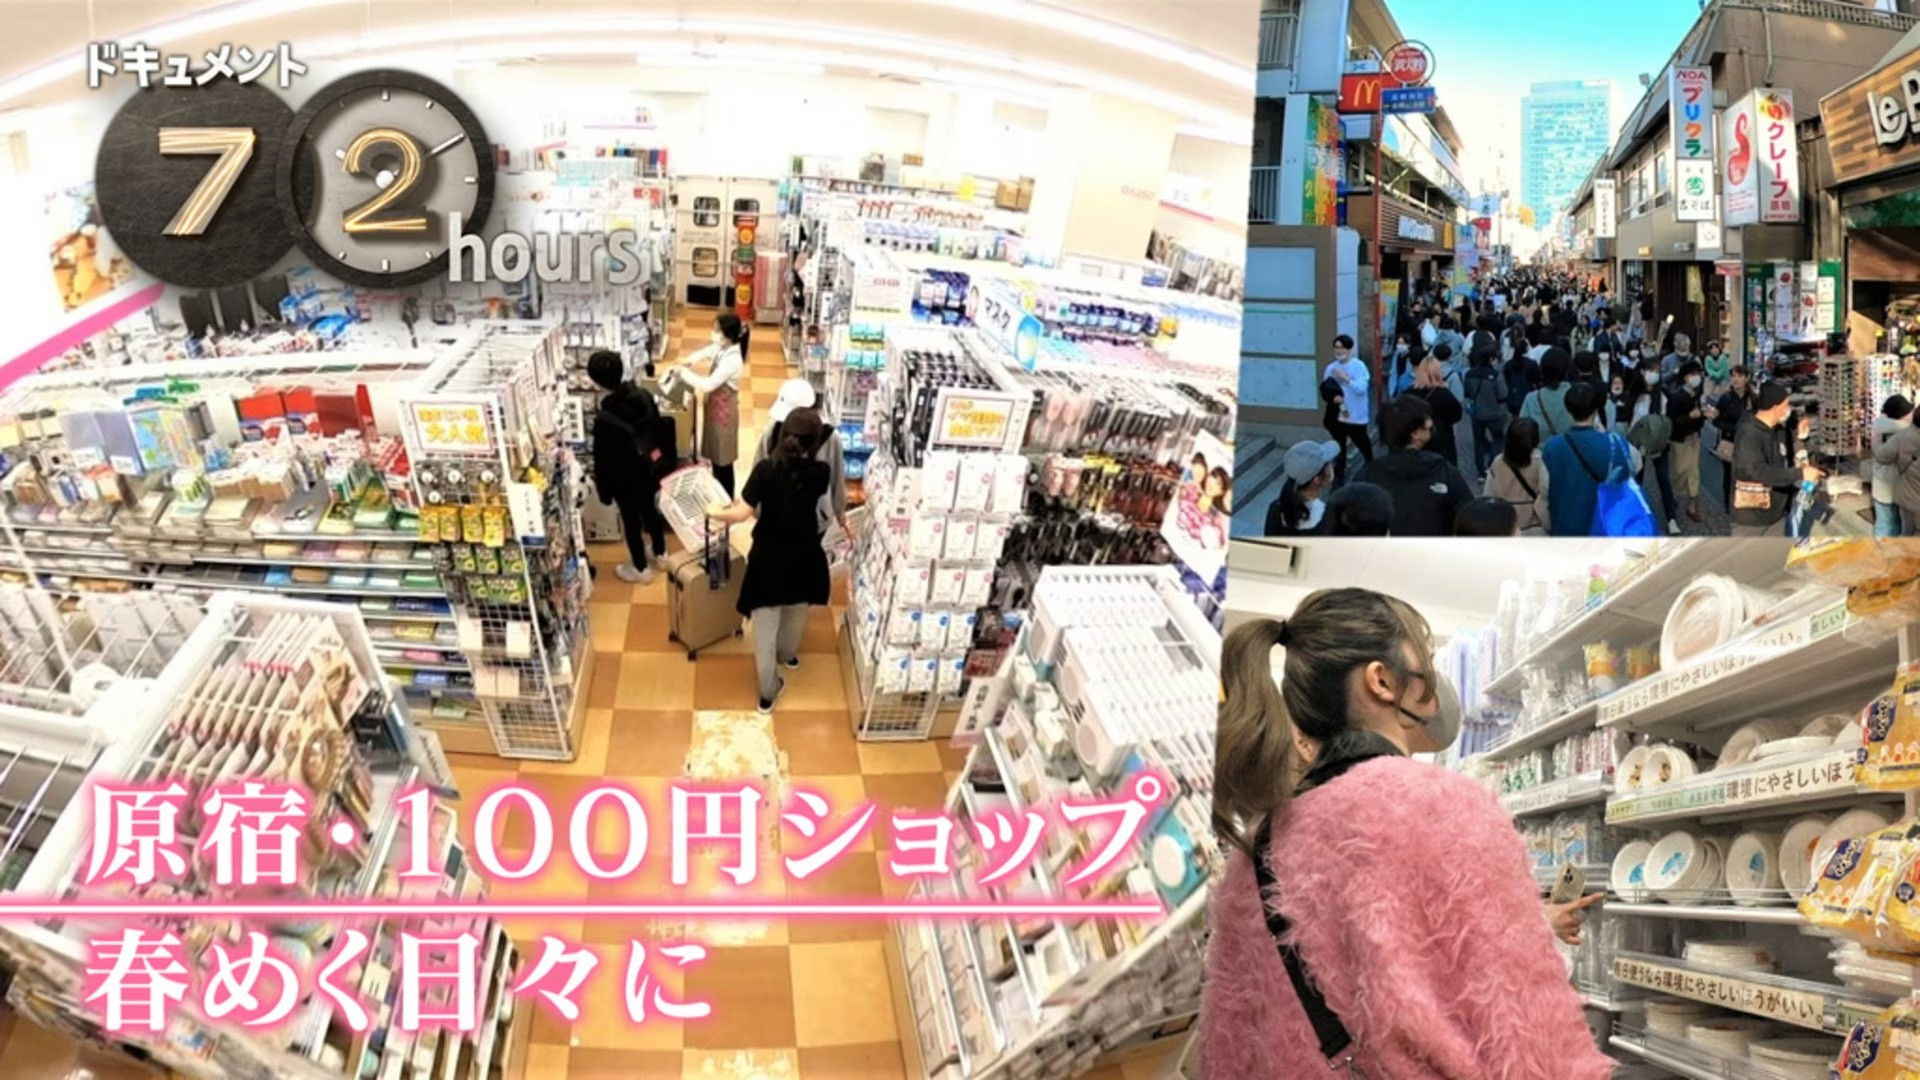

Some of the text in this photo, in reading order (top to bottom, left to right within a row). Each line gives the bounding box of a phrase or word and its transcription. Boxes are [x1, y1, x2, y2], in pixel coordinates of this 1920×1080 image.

[1682, 86, 1702, 156] プリクラ
[984, 296, 1011, 329] マスク
